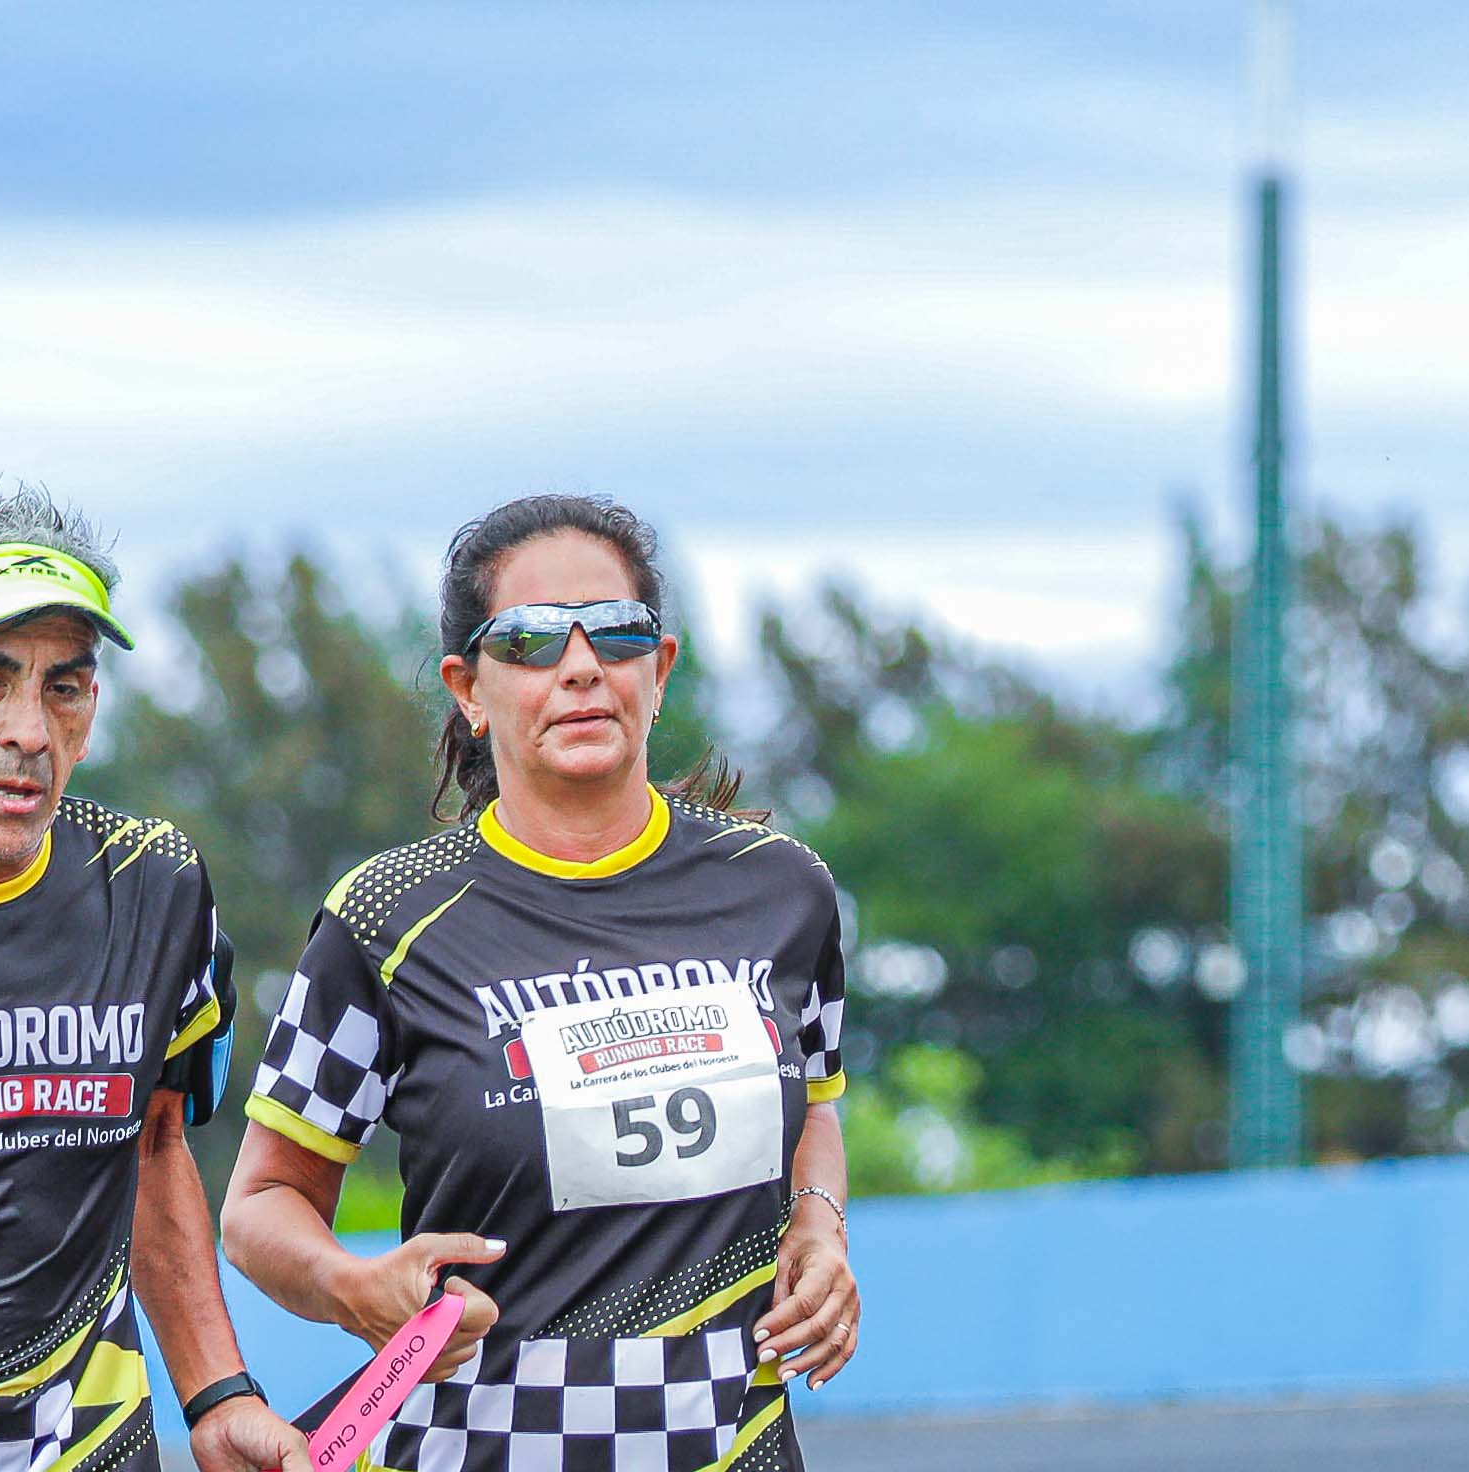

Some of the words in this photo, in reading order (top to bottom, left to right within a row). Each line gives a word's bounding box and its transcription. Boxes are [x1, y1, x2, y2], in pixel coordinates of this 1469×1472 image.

[560, 1004, 729, 1055] AUTÓDROMO
[595, 1039, 662, 1068] RUNNING
[666, 1036, 707, 1053] RACE
[570, 1081, 582, 1090] La
[583, 1075, 618, 1088] Carrera
[620, 1070, 633, 1081] de
[634, 1067, 648, 1078] los
[649, 1062, 682, 1075] Clubes
[33, 1080, 109, 1113] RACE
[484, 1090, 506, 1109] La
[54, 1128, 82, 1148] del
[611, 1087, 717, 1168] 59
[360, 1335, 426, 1418] Originale
[318, 1423, 358, 1467] Club
